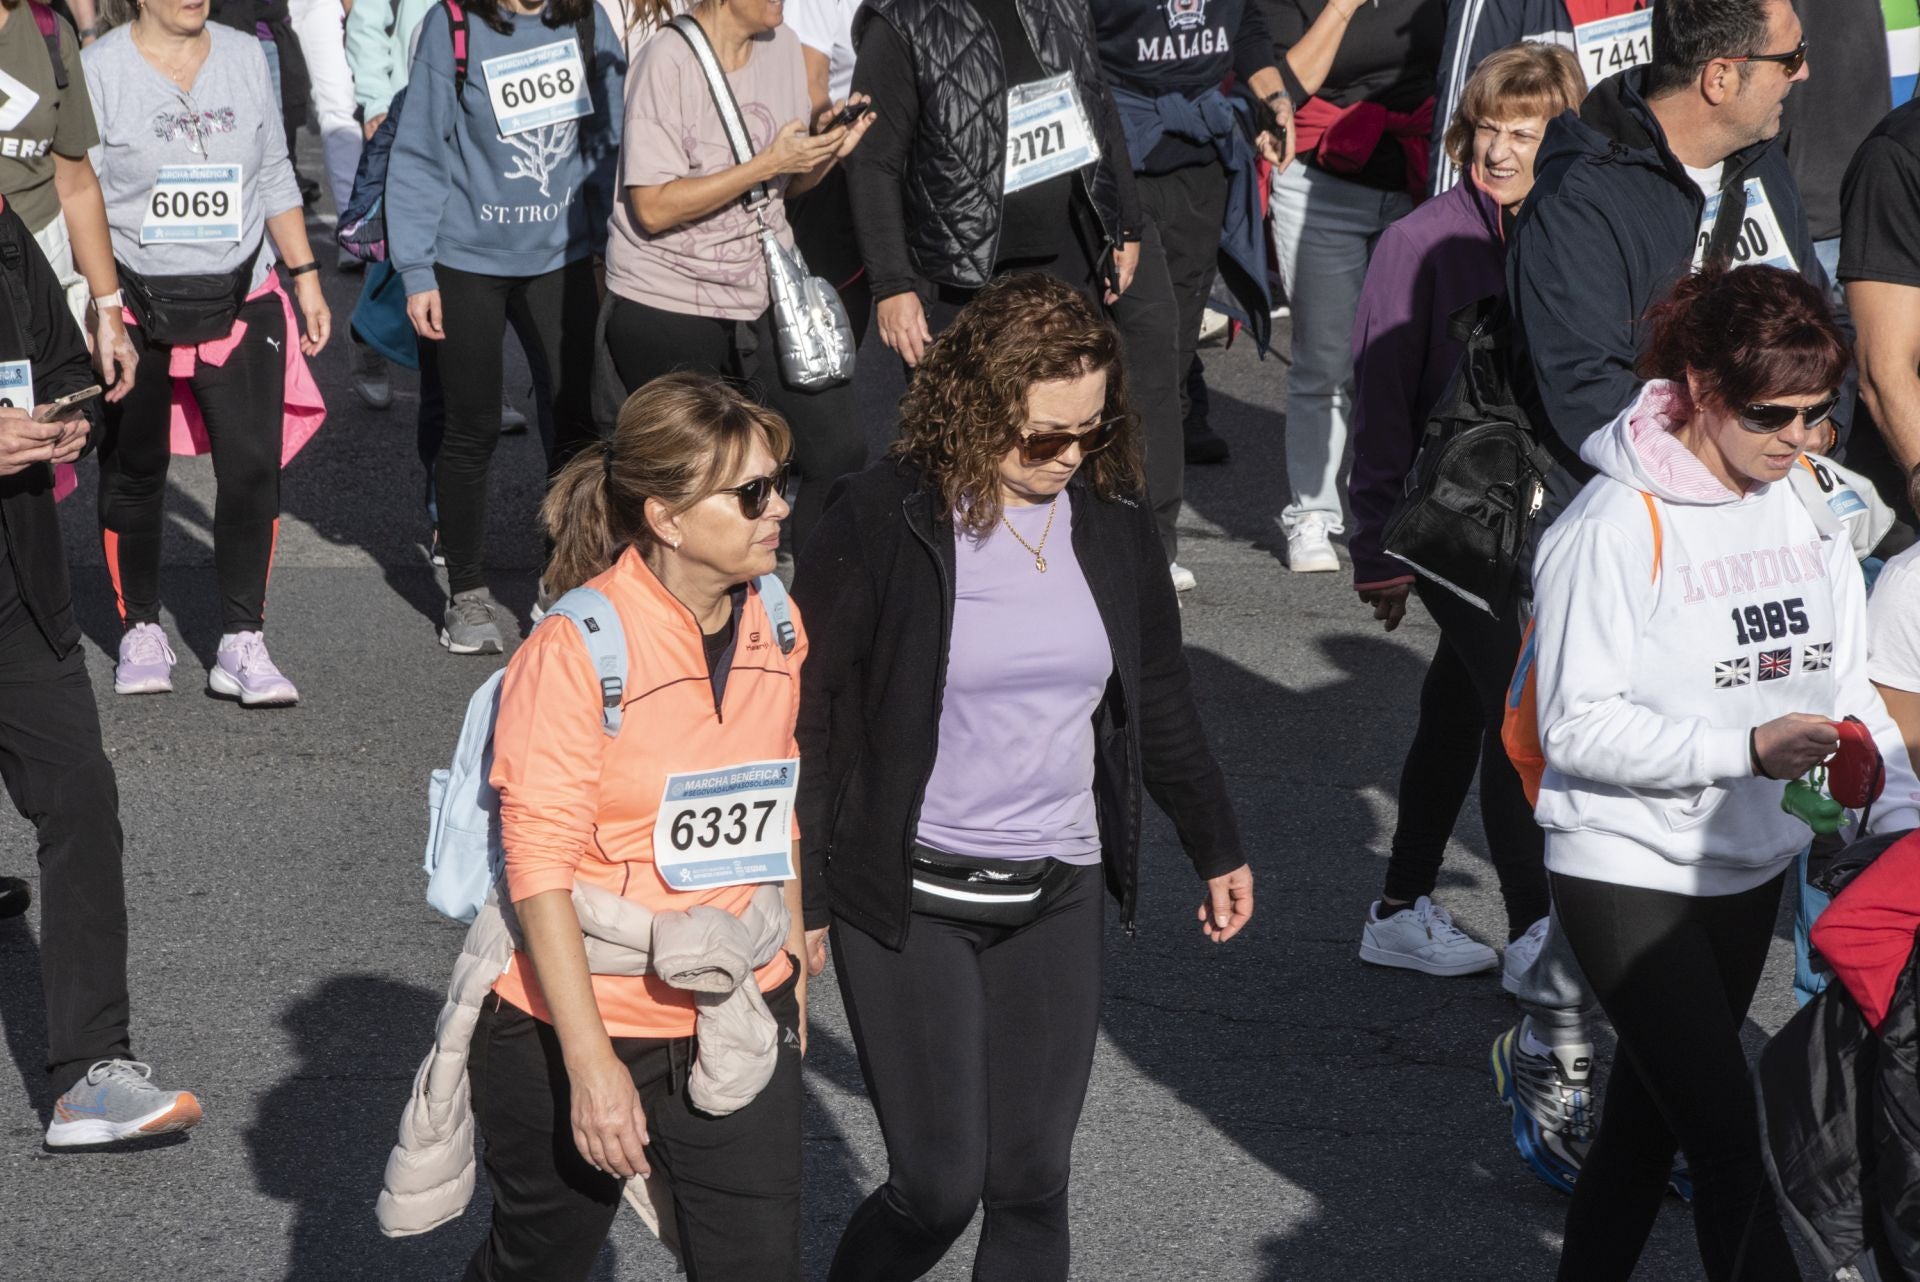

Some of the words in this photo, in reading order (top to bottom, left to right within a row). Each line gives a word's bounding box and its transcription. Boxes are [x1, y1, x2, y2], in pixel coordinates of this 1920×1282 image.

[1137, 26, 1229, 61] MALAGA
[1588, 34, 1652, 75] 7441
[501, 68, 575, 108] 6068
[0, 137, 53, 157] ERS
[1007, 119, 1066, 168] 2727
[152, 190, 229, 218] 6069
[480, 203, 511, 224] ST.
[515, 199, 565, 224] TRO
[1677, 541, 1826, 605] LONDON
[1731, 597, 1810, 646] 1985
[684, 775, 729, 791] MARCHA
[730, 768, 780, 784] BENÉFICA
[670, 800, 778, 851] 6337
